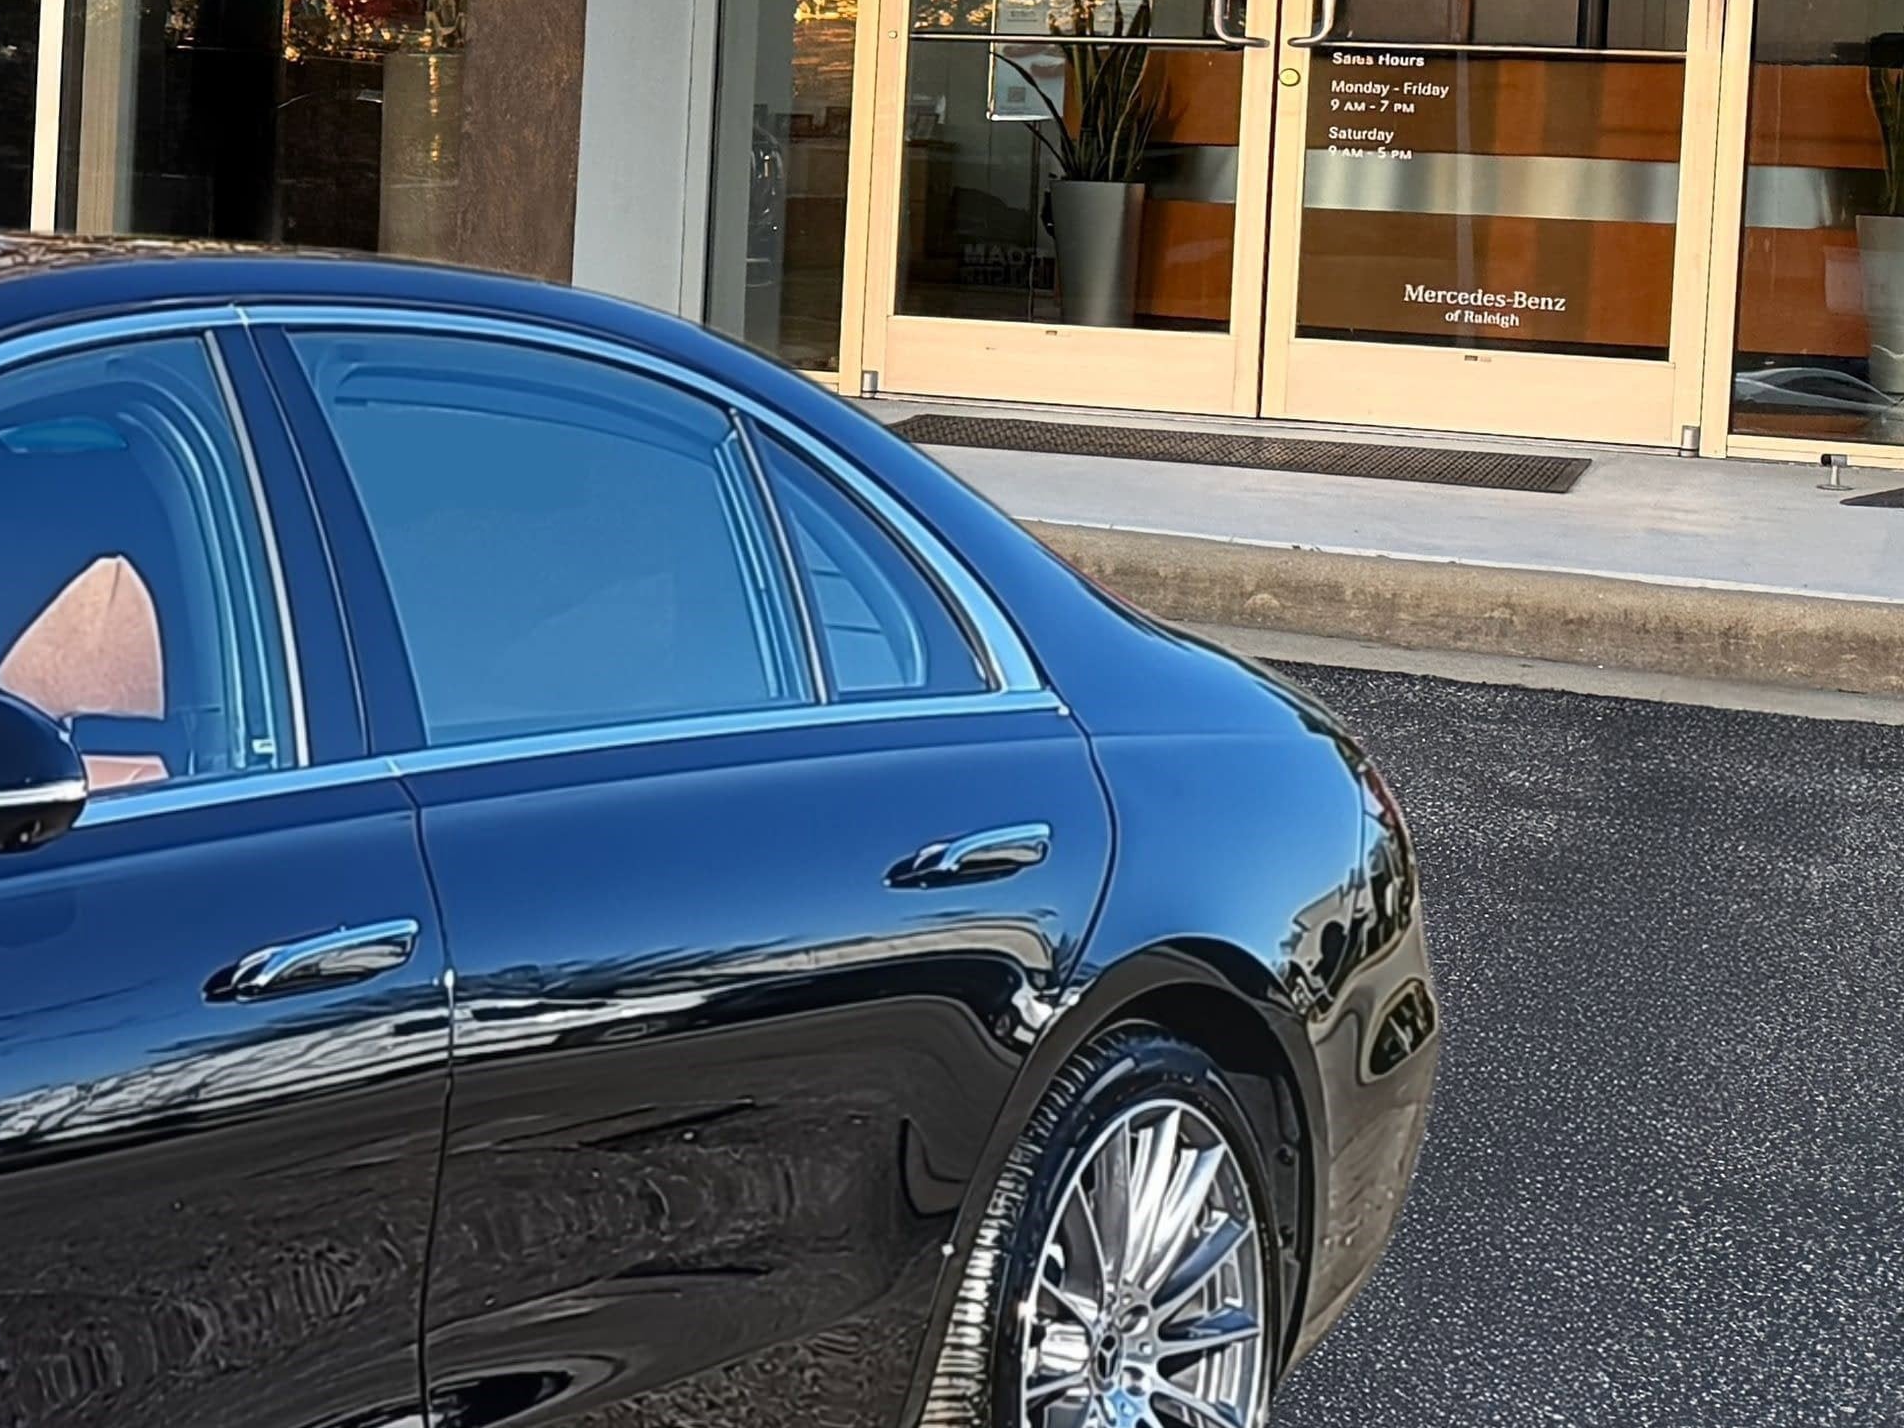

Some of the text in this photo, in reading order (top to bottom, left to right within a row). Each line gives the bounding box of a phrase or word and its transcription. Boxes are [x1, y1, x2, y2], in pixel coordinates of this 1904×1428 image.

[1378, 53, 1425, 67] Hours
[1331, 80, 1390, 97] Monday
[1403, 82, 1450, 99] Friday
[1330, 99, 1340, 111] 9
[1343, 102, 1366, 112] AM
[1380, 100, 1389, 112] 7
[1393, 103, 1415, 113] PM
[1328, 126, 1395, 144] Saturday
[1328, 145, 1337, 157] 9
[1341, 148, 1364, 158] AM
[1377, 147, 1386, 159] 5
[1391, 150, 1413, 160] PM
[1404, 284, 1567, 312] Mercedes-Benz
[1445, 310, 1520, 328] of Raleigh
